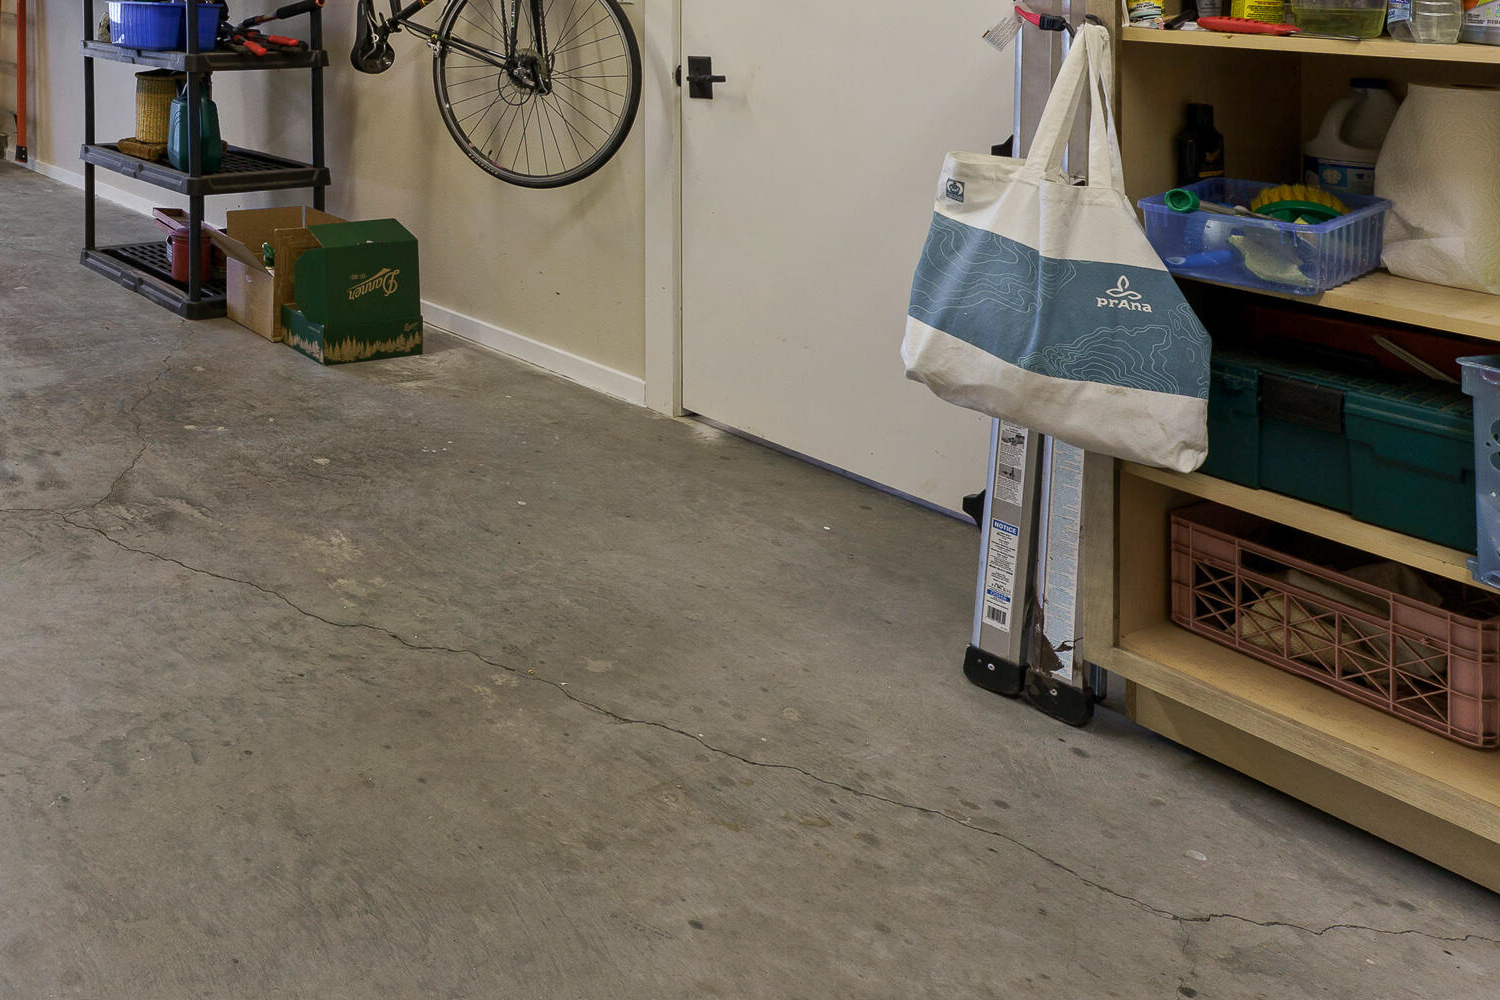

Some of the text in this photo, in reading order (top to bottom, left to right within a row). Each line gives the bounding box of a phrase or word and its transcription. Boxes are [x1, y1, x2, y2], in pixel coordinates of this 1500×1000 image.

[348, 269, 400, 300] Danner
[1096, 297, 1153, 313] prAna
[994, 520, 1018, 536] NOTICE
